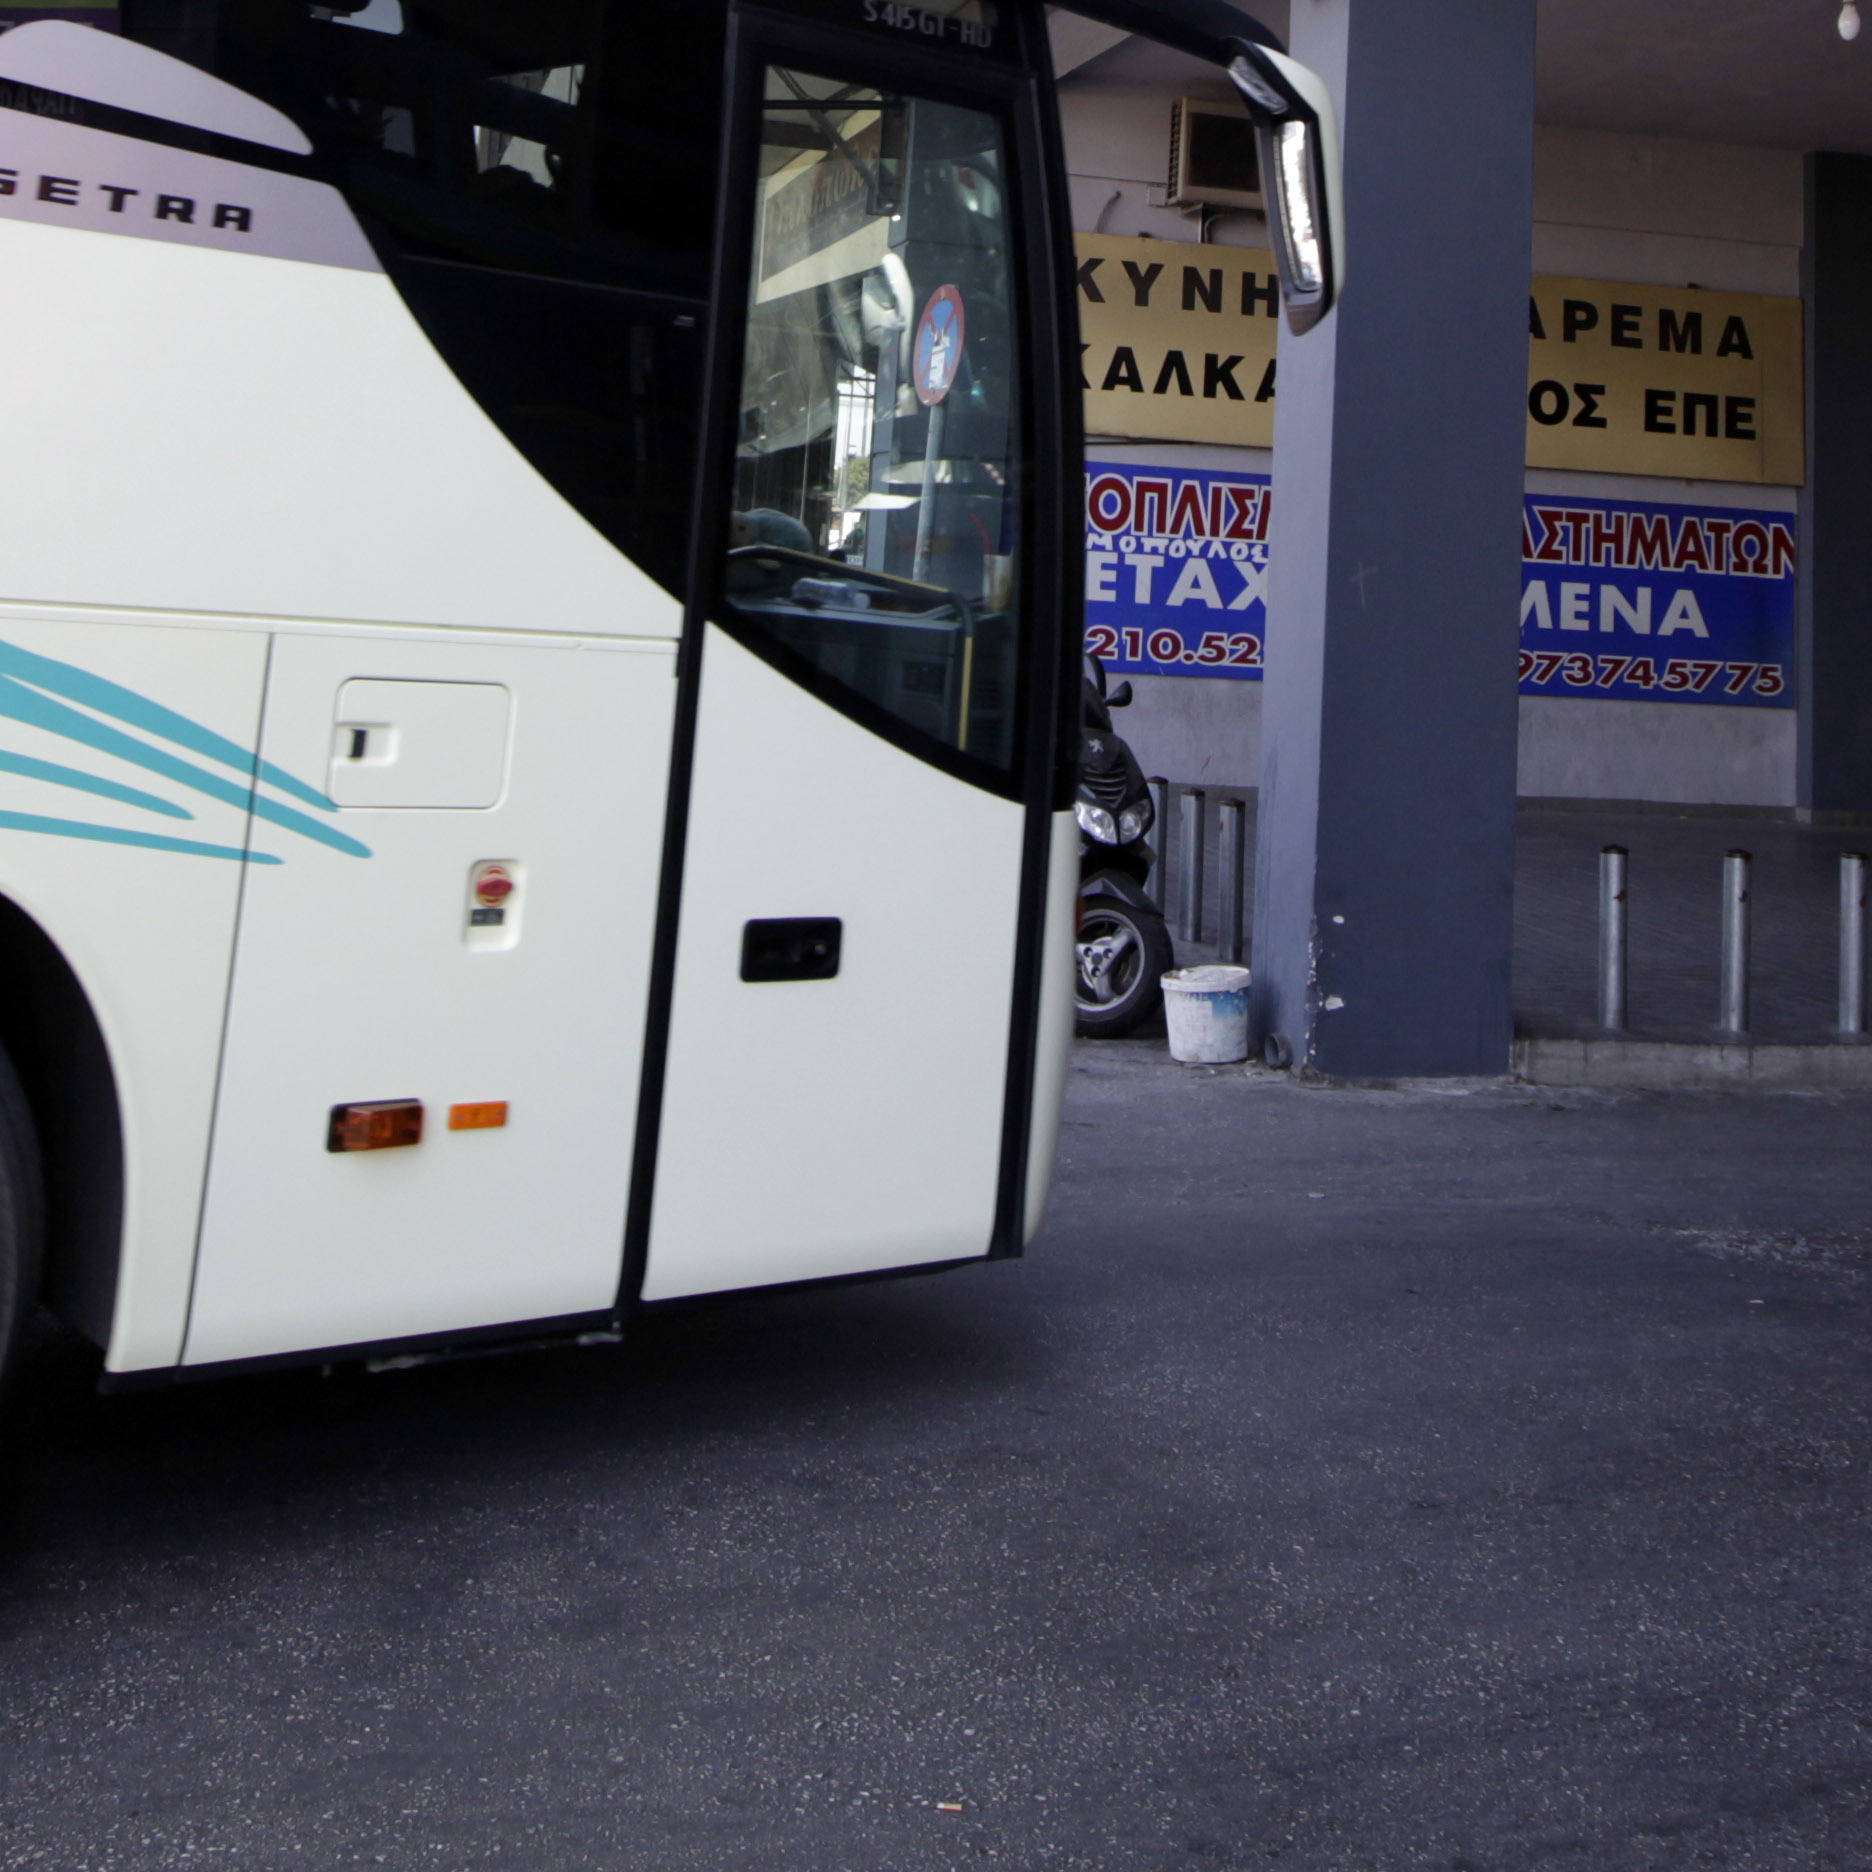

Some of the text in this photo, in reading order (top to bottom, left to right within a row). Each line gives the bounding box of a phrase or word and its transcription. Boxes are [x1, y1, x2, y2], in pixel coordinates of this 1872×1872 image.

[1080, 344, 1277, 402] ΑΛΚΑ
[1644, 389, 1756, 440] ΕΠΕ
[1522, 504, 1794, 580] ΣΤΗΜΑΤΩΝ
